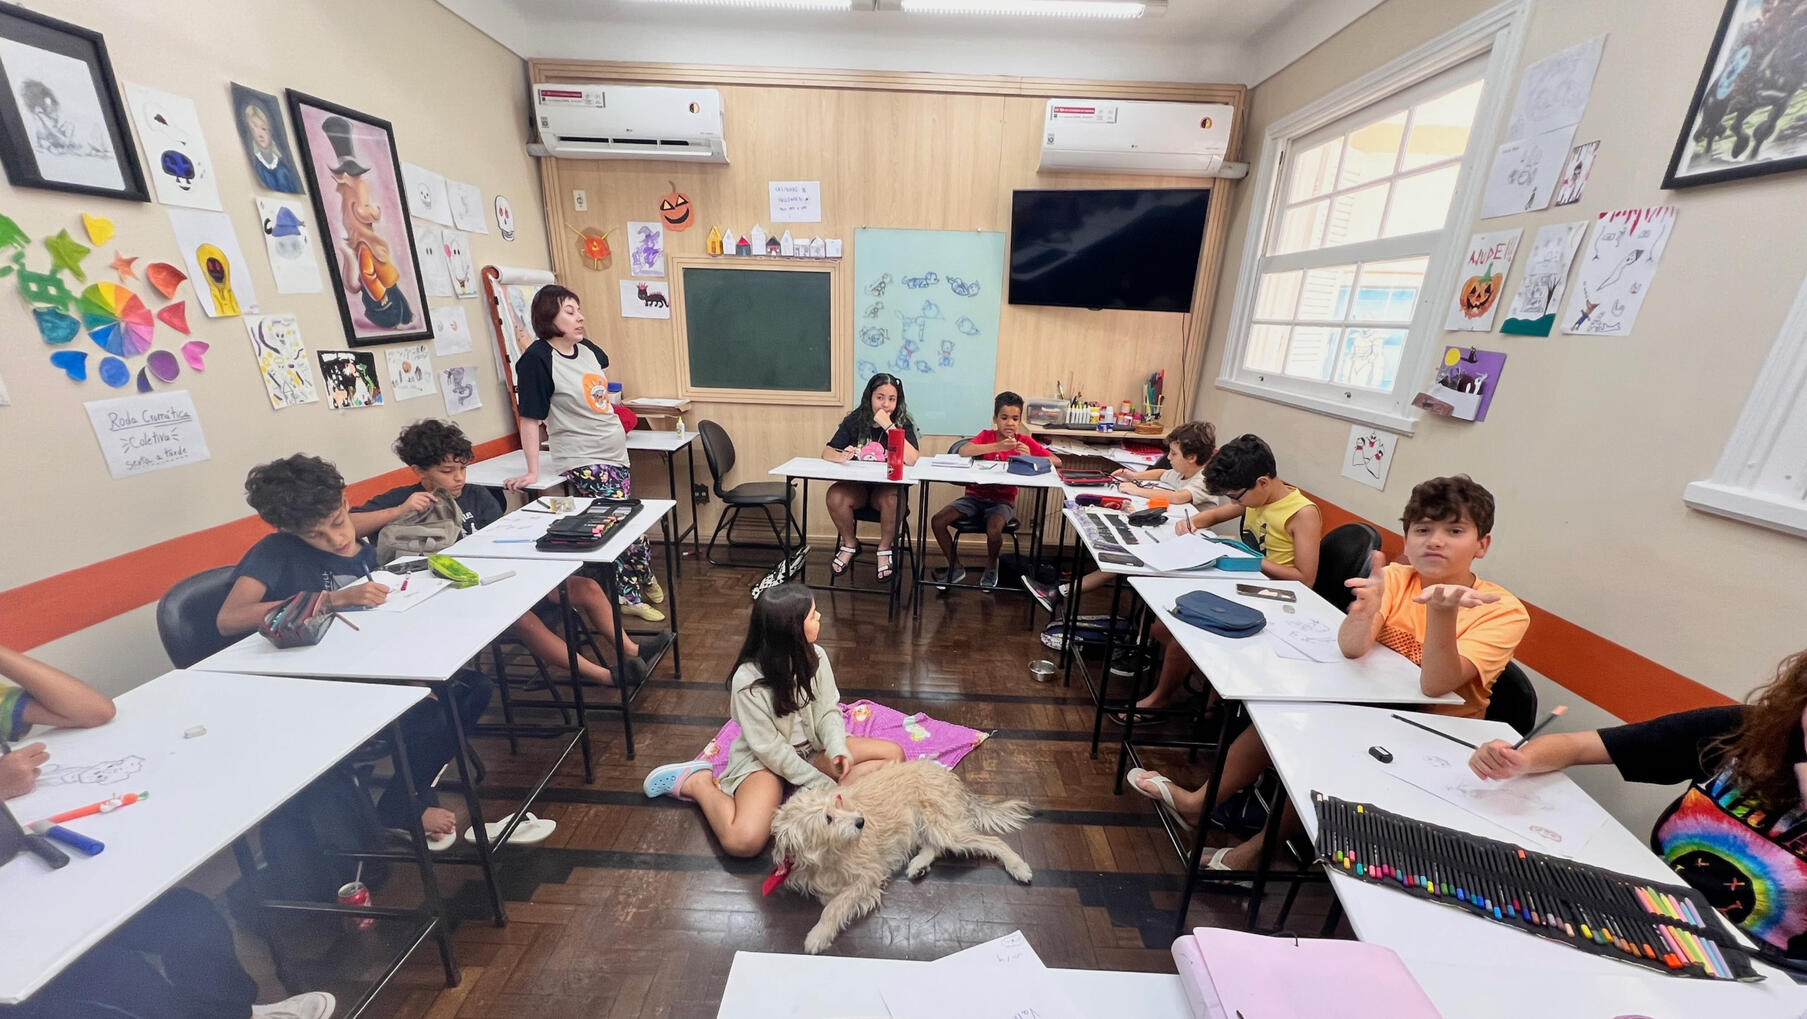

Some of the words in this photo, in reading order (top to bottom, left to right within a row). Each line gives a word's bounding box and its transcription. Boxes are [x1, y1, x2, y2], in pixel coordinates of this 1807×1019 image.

[107, 410, 138, 430] Roda
[142, 406, 191, 423] Cromática
[128, 432, 170, 449] Coletiva
[164, 446, 188, 457] tarde
